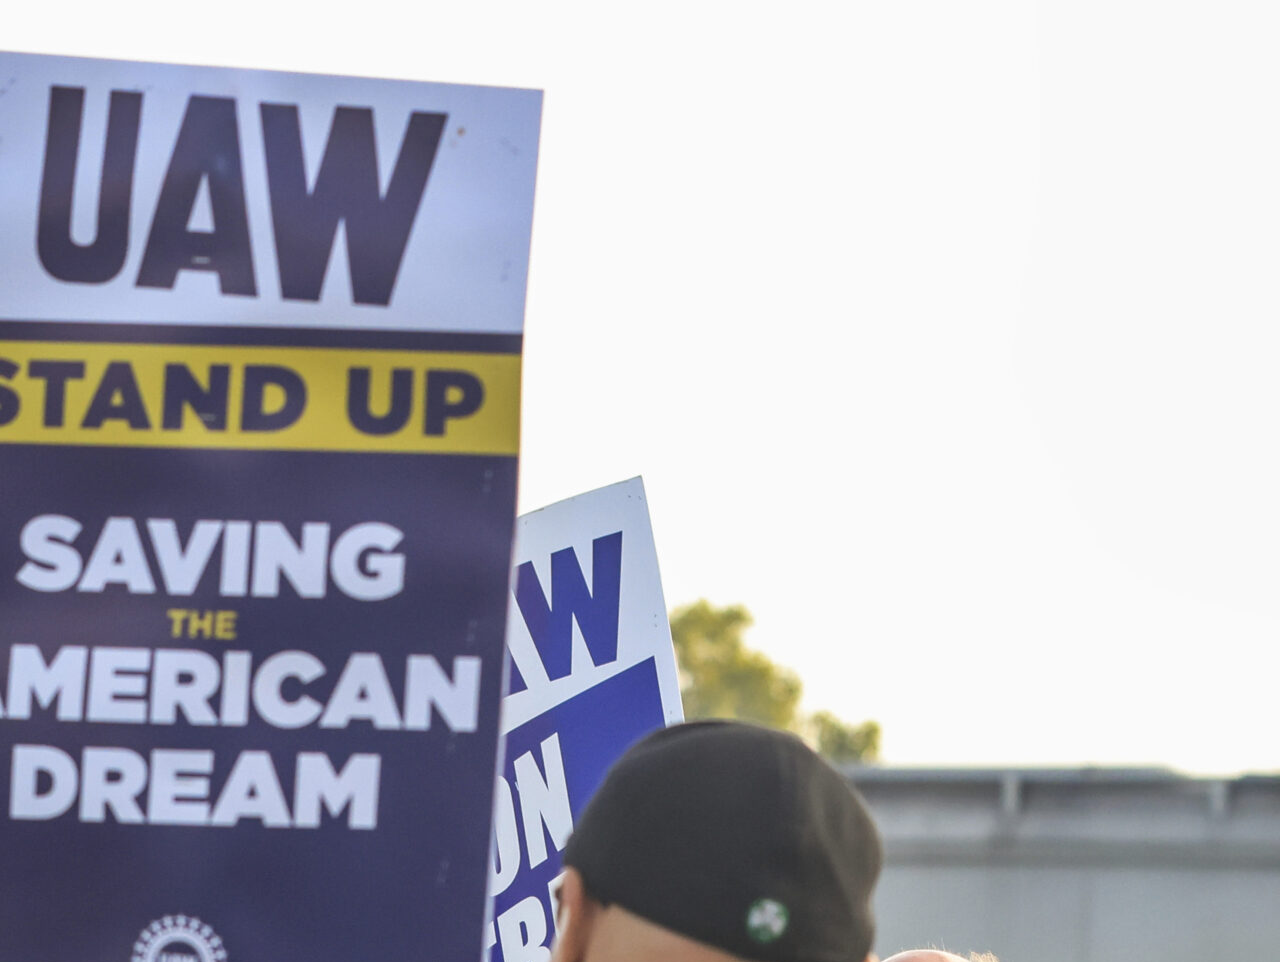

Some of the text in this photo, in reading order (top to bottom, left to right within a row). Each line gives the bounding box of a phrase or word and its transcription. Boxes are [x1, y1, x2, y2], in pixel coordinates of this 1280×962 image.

[36, 84, 449, 308] UAW
[346, 366, 485, 438] UP
[16, 513, 406, 601] SAVING
[167, 609, 237, 640] THE
[9, 744, 381, 831] DREAM
